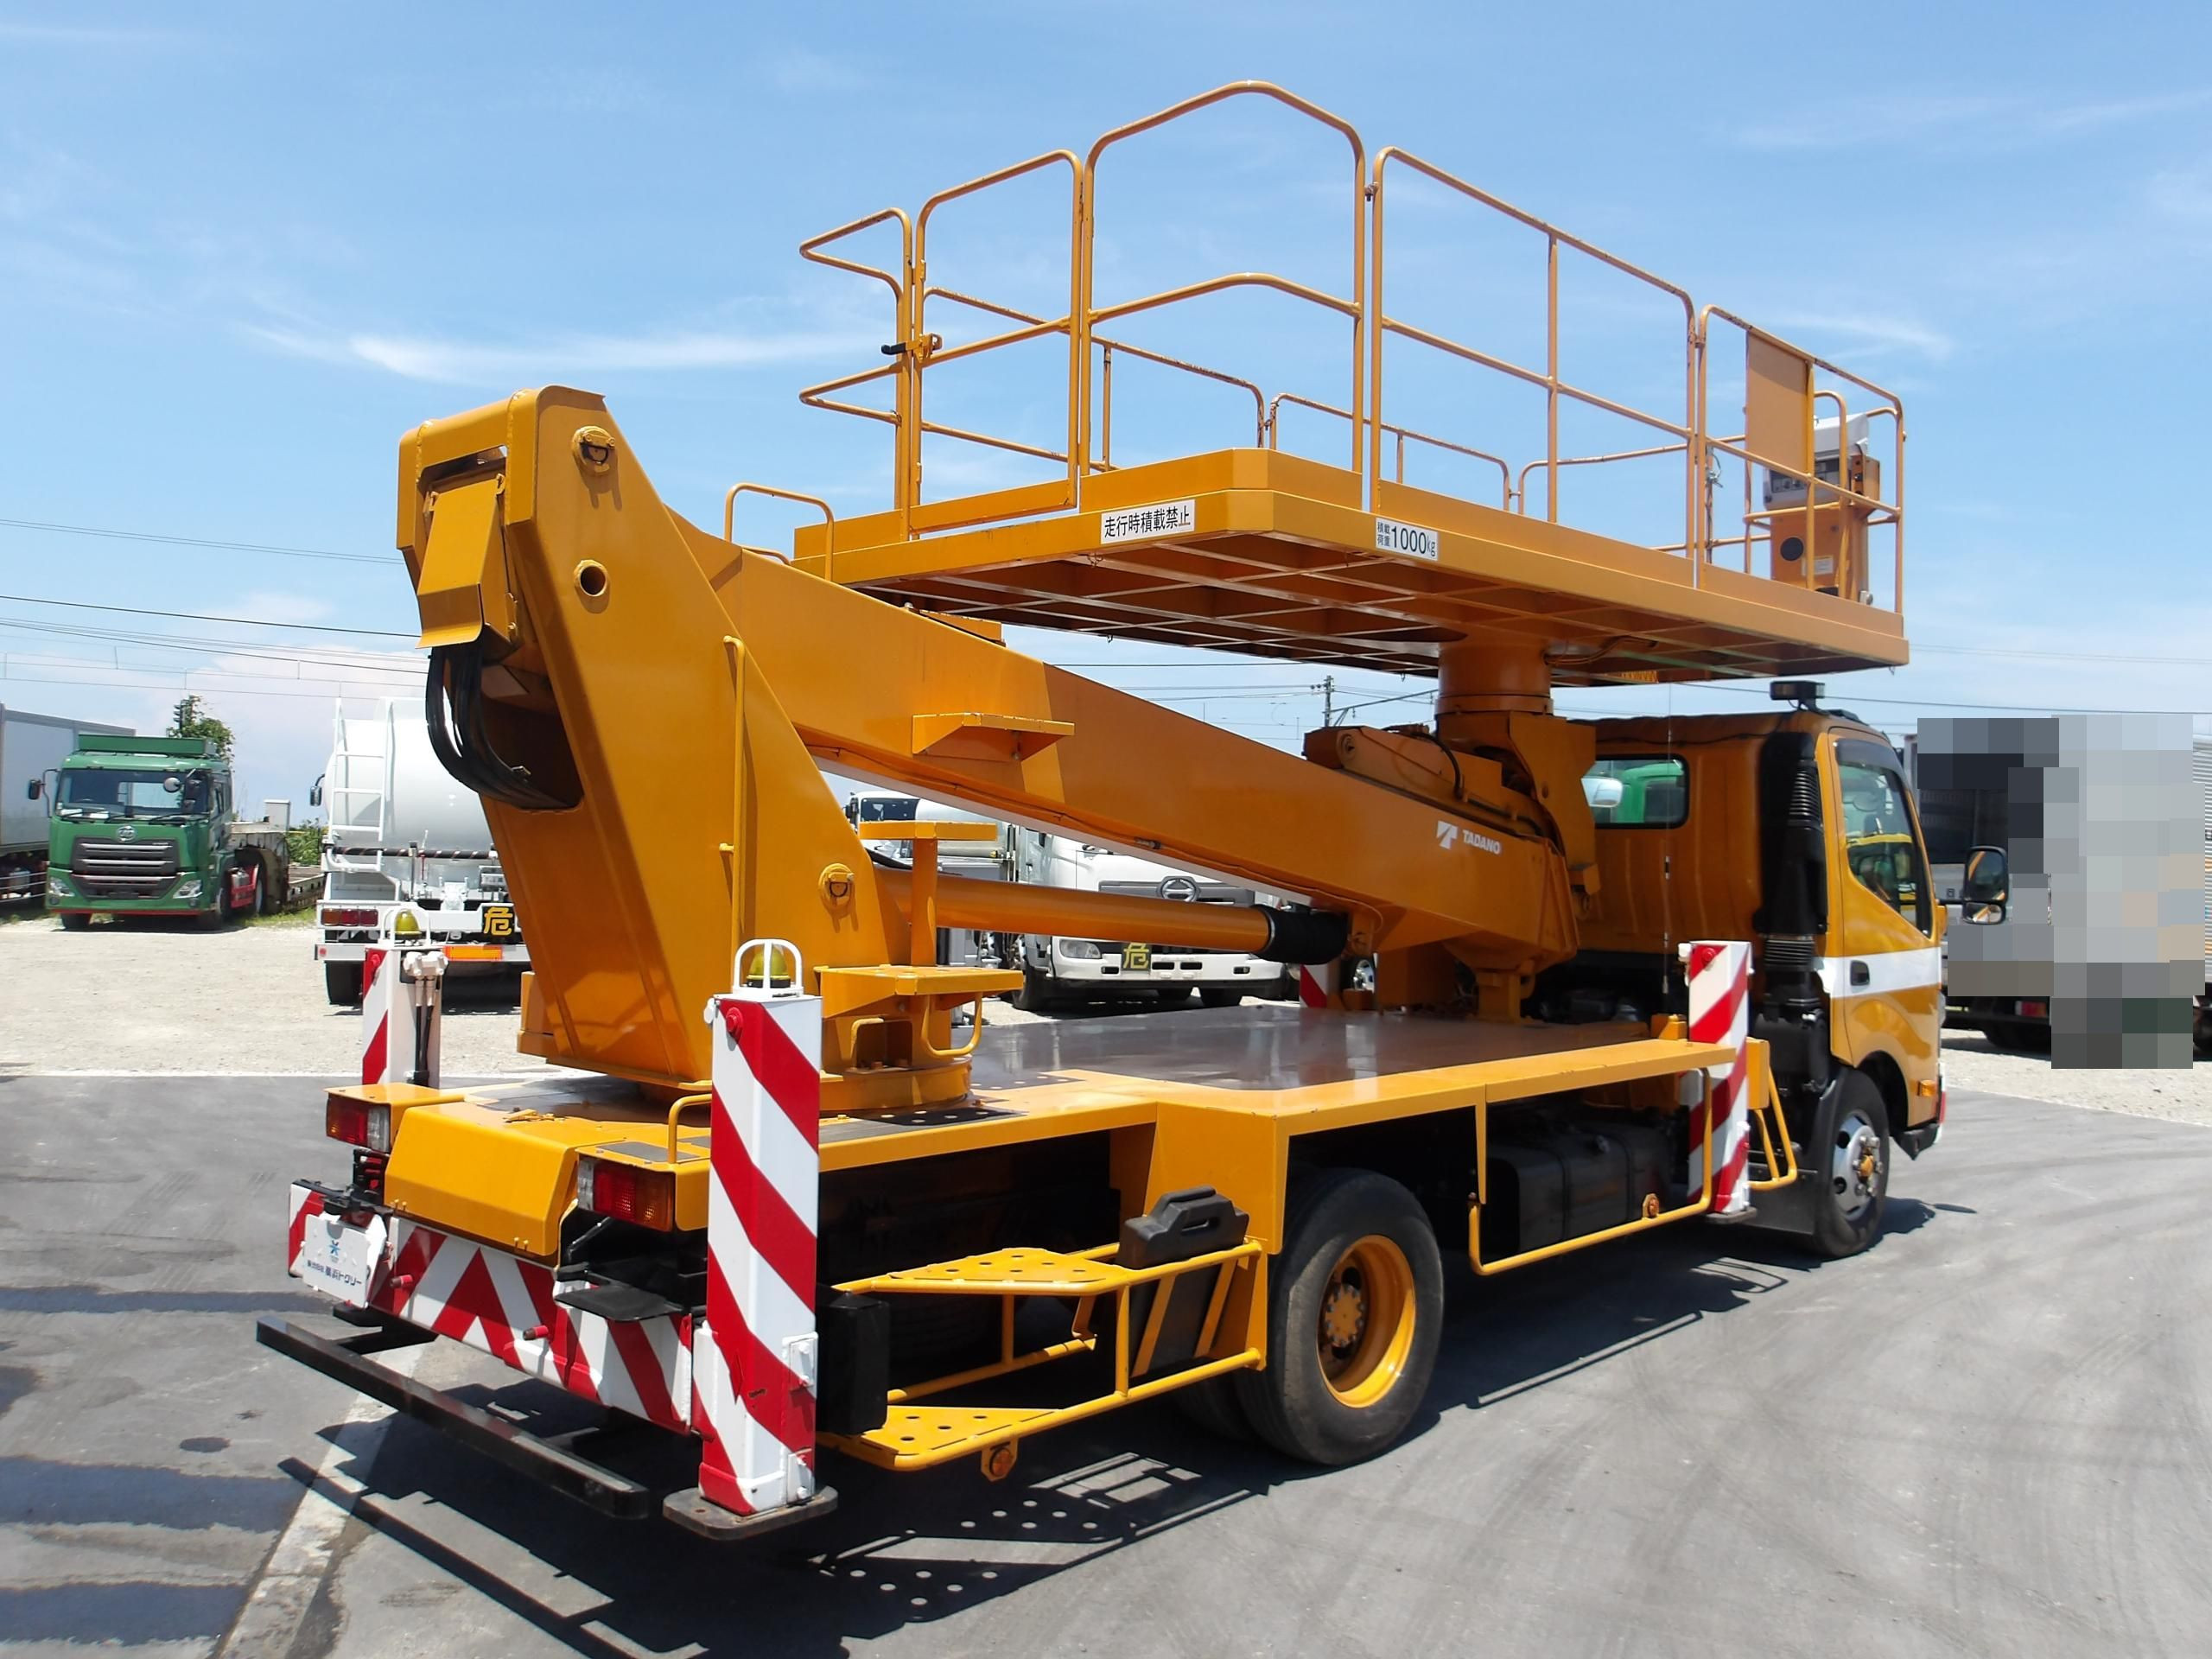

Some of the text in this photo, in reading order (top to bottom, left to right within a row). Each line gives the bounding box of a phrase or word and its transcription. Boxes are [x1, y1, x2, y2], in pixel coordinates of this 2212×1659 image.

[1104, 505, 1191, 538] 走行時積載禁止
[1462, 829, 1501, 855] TADANO
[484, 906, 513, 936] 危
[1123, 942, 1149, 969] 危
